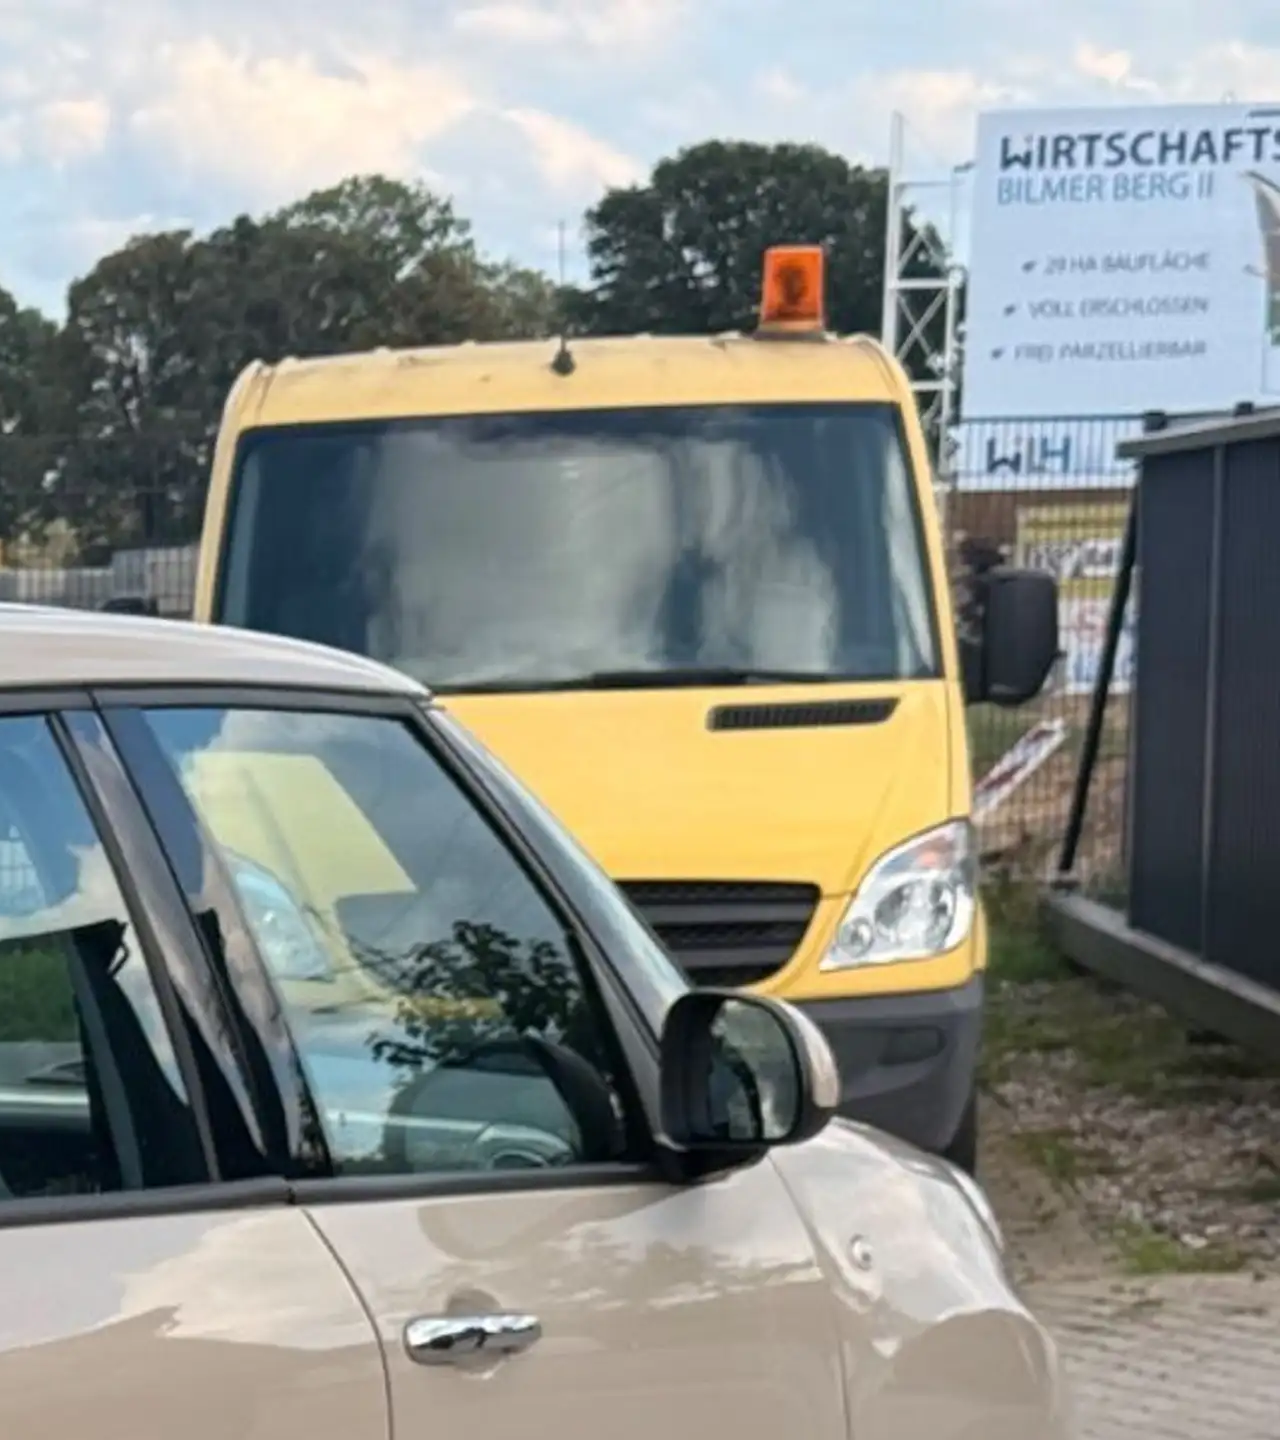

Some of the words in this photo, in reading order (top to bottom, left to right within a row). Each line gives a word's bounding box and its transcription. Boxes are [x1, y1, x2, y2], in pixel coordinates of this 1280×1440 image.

[997, 174, 1103, 205] BILMER
[1112, 171, 1190, 202] BERG
[1027, 299, 1074, 319] VOLL
